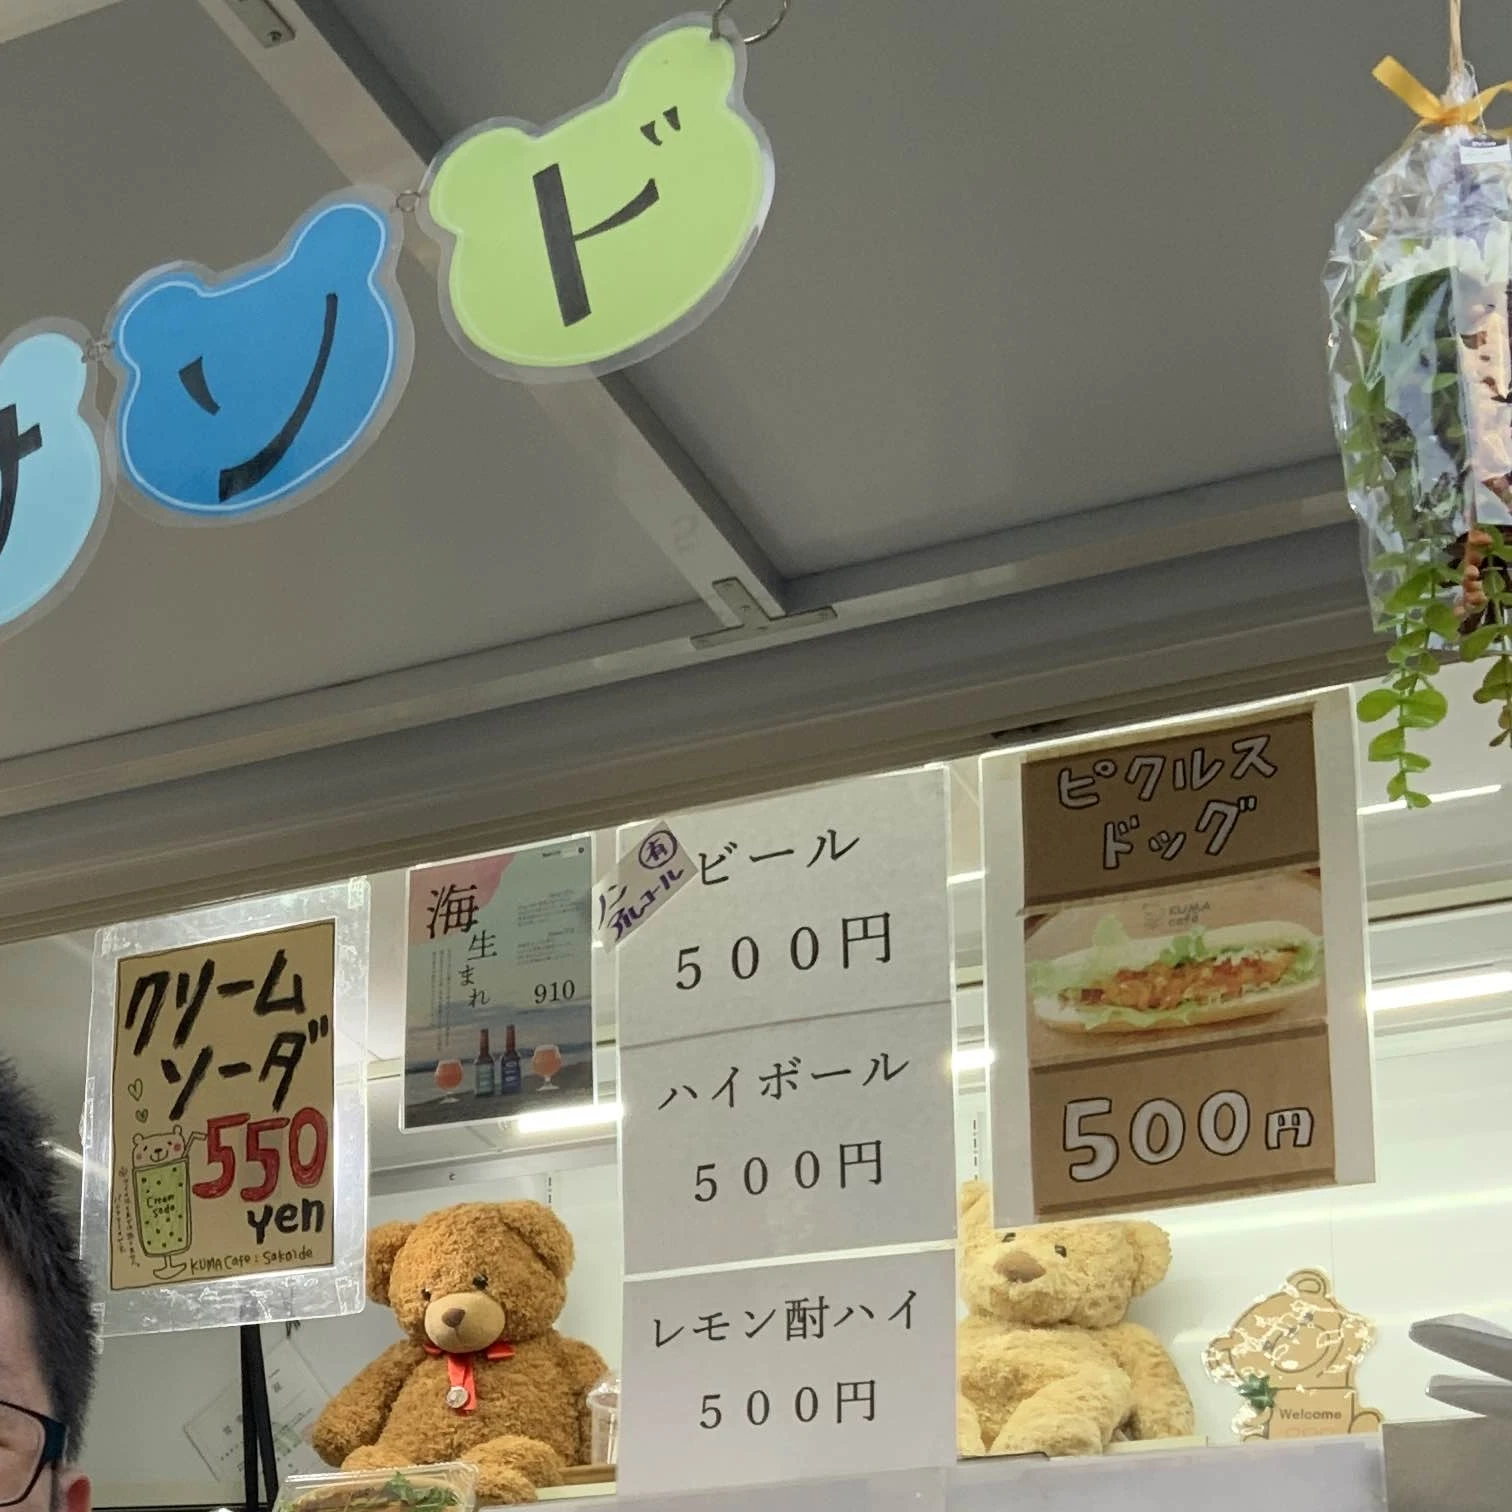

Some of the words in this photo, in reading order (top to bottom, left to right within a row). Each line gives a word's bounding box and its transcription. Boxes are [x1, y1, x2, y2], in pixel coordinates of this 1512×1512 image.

[1058, 734, 1277, 808] ピクルス
[697, 827, 862, 886] ビール
[1101, 796, 1257, 870] ドッグ
[674, 912, 892, 991] 500円
[125, 950, 306, 1056] クリーム
[534, 979, 575, 1004] 910
[161, 1016, 329, 1121] ソーダ
[658, 1052, 910, 1110] ハイボール
[193, 1107, 328, 1202] 550
[1062, 1089, 1314, 1183] 500円
[694, 1140, 883, 1203] 500円
[247, 1198, 325, 1245] yen
[653, 1289, 918, 1349] レモン酎ハイ
[699, 1379, 877, 1430] 500円
[1279, 1407, 1342, 1423] Welcome
